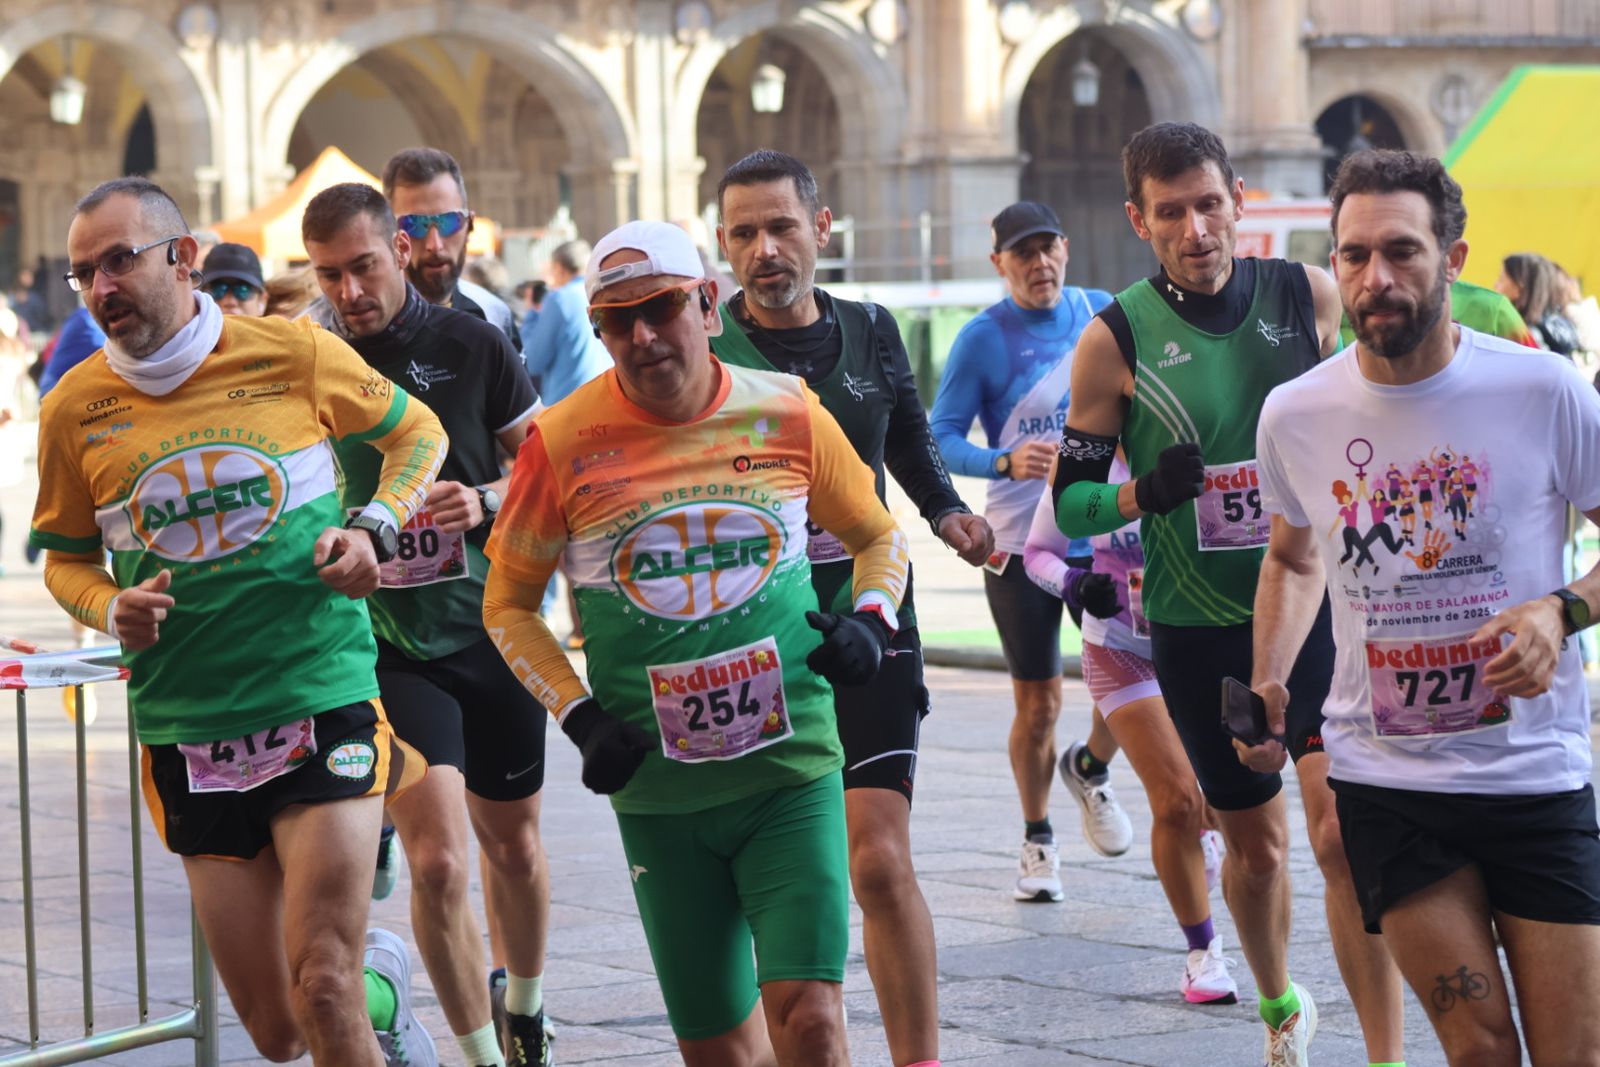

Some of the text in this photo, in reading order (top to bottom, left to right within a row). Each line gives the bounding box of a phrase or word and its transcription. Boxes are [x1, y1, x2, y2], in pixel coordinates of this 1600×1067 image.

[1157, 352, 1192, 368] VIATOR
[115, 451, 150, 495] CLUB
[159, 428, 280, 453] DEPORTIVO
[141, 475, 275, 532] ALCER
[604, 484, 782, 541] CLUB DEPORTIVO
[1222, 488, 1263, 523] 59
[397, 529, 440, 561] 80
[629, 536, 771, 582] ALCER
[1436, 555, 1483, 570] CARRERA
[1400, 573, 1424, 582] CONTRA
[1424, 573, 1433, 581] LA
[1433, 567, 1466, 579] VIOLENCIA
[1466, 567, 1474, 576] DE
[622, 579, 778, 634] SALAMANCA
[1366, 616, 1378, 627] de
[1382, 614, 1441, 626] noviembre
[1445, 611, 1459, 621] de
[1372, 601, 1413, 613] MAYOR
[1415, 600, 1432, 611] DE
[1436, 589, 1509, 609] SALAMANCA
[651, 650, 779, 697] bedunia
[1396, 664, 1477, 707] 727
[682, 681, 761, 731] 254
